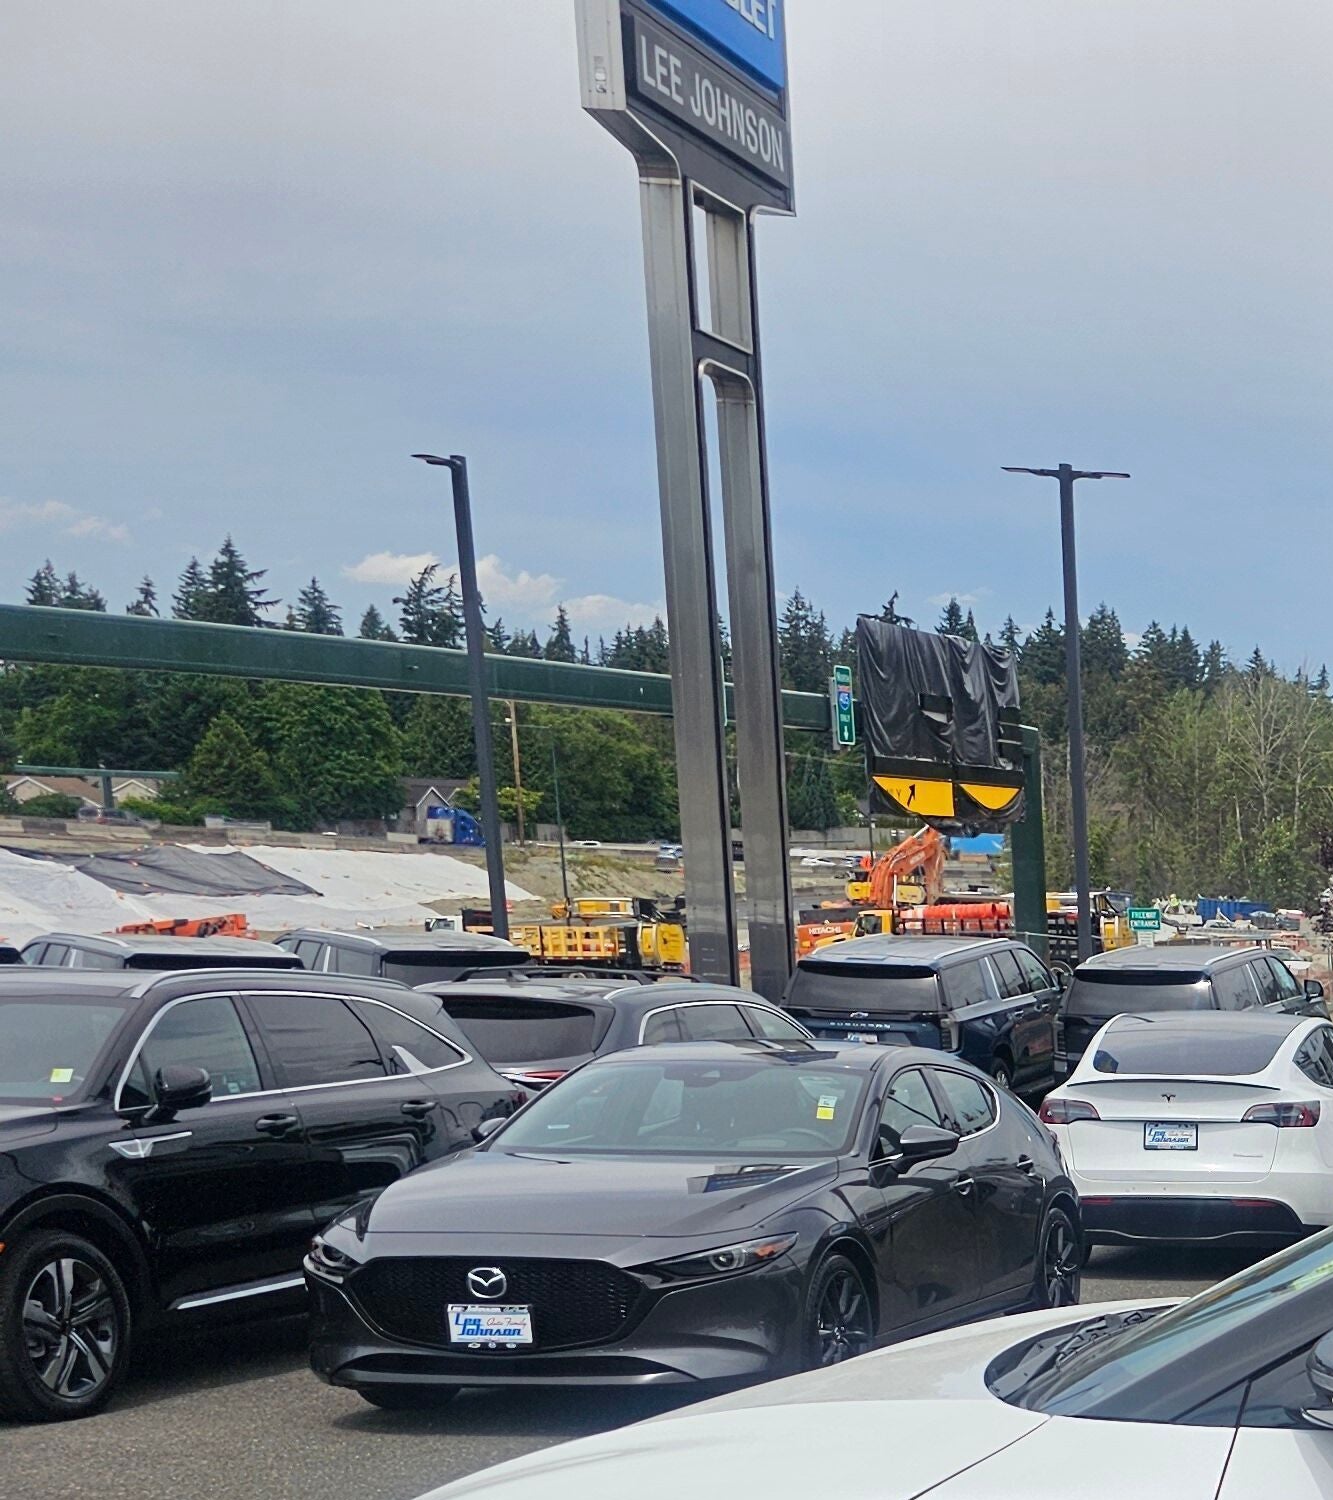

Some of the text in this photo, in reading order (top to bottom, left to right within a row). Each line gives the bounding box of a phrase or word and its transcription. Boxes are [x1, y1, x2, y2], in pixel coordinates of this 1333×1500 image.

[640, 34, 785, 173] LEE JOHNSON
[808, 926, 841, 935] HITACHI
[455, 1312, 481, 1326] Lee
